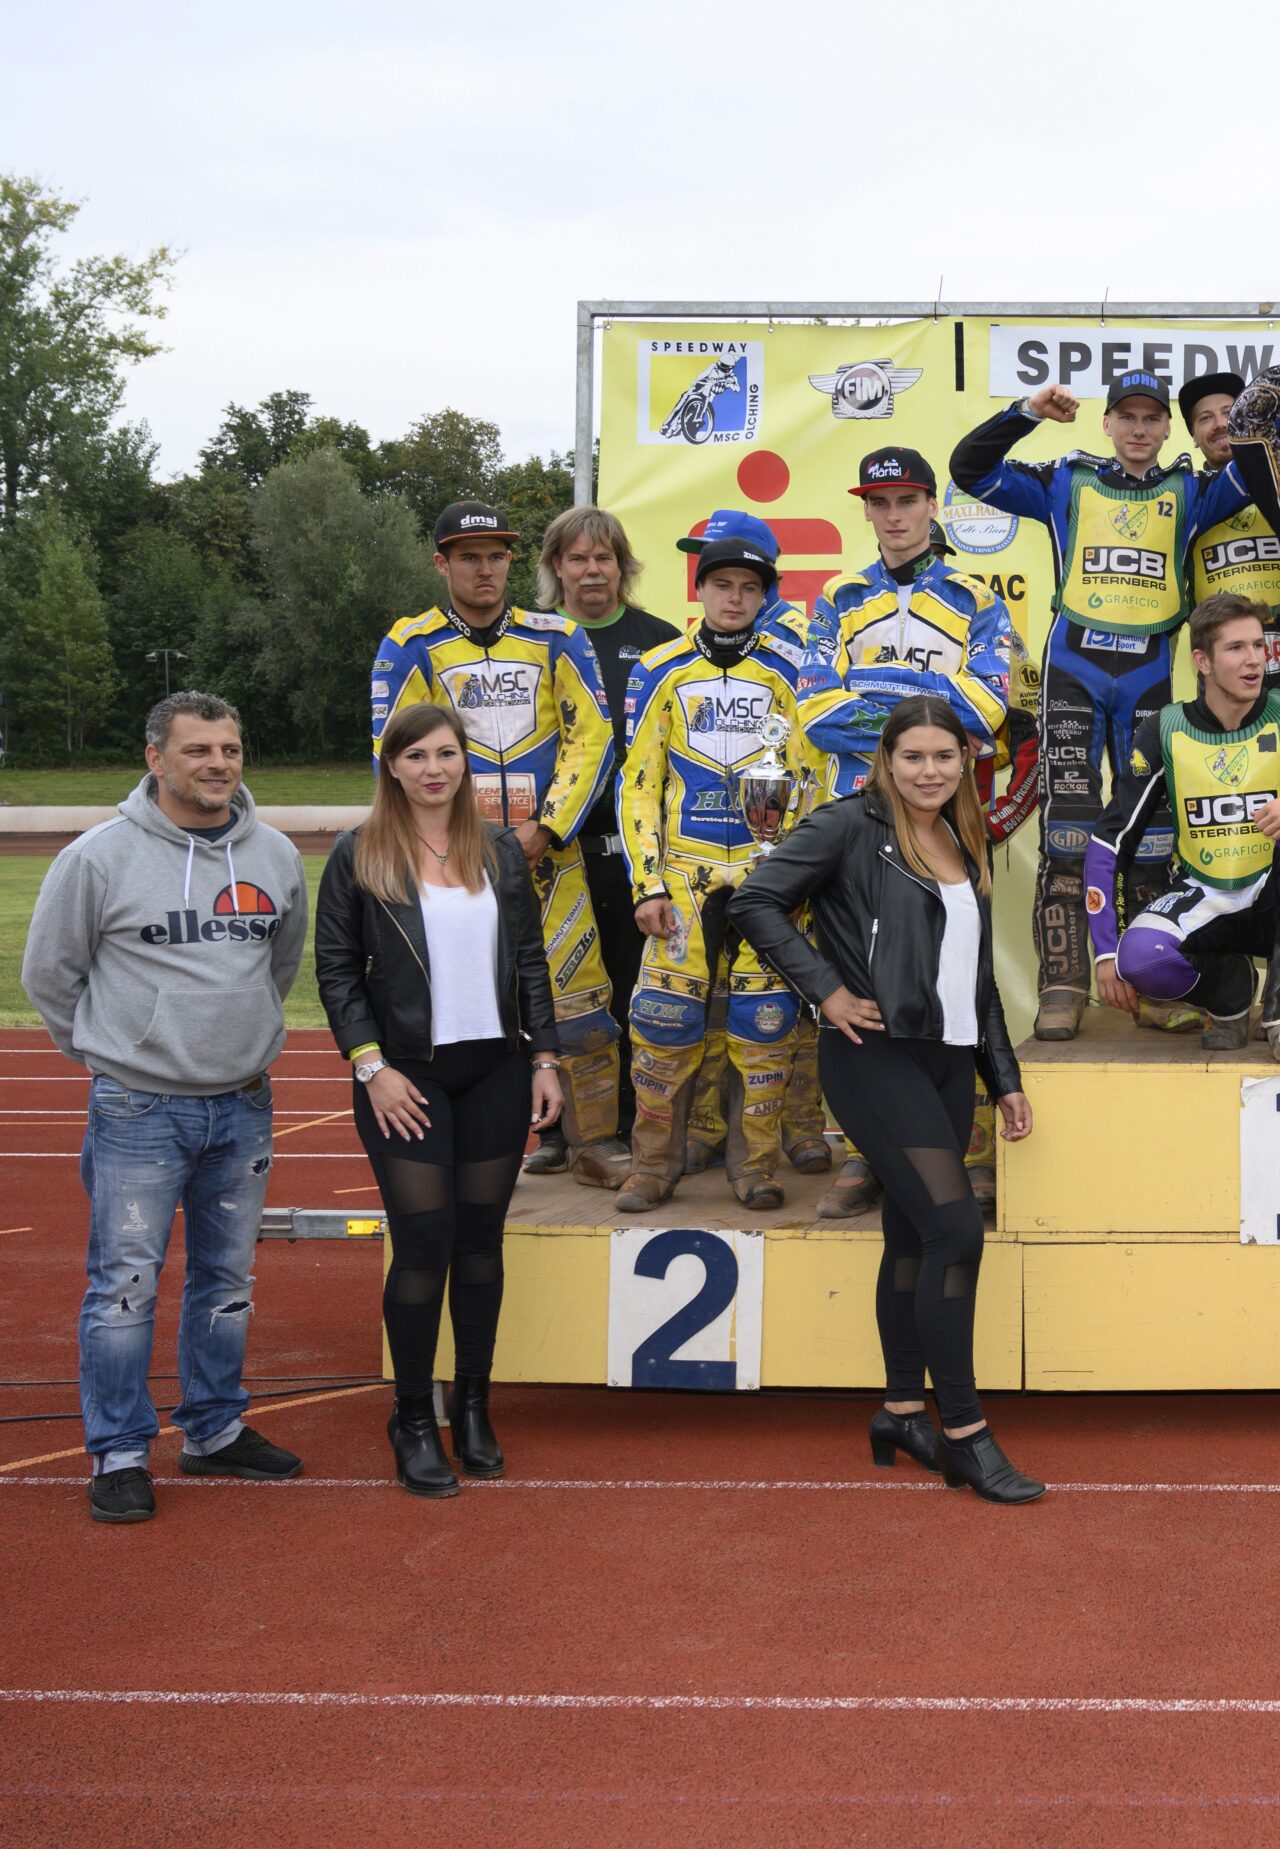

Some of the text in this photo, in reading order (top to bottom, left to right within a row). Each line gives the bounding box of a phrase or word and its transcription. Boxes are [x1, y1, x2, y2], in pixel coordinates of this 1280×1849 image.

[652, 341, 747, 353] SPEEDWAY
[844, 377, 884, 401] FIM
[1122, 375, 1158, 389] BOHN
[744, 383, 759, 440] OLCHING
[713, 432, 741, 443] MSC
[872, 465, 903, 479] Härtel
[1157, 501, 1173, 518] 12
[1084, 547, 1165, 578] JCB
[1082, 576, 1167, 591] STERNBERG
[1104, 594, 1159, 608] GRAFICIO
[446, 608, 471, 637] WACO
[481, 670, 529, 693] MSC
[716, 697, 764, 719] MSC
[1048, 746, 1087, 760] JCB
[1214, 842, 1271, 858] GRAFICIO
[140, 909, 281, 945] ellesse
[1045, 903, 1069, 974] JCB
[634, 1072, 668, 1094] ZUPIN
[747, 1071, 784, 1085] ZUPIN
[632, 1229, 738, 1390] 2
